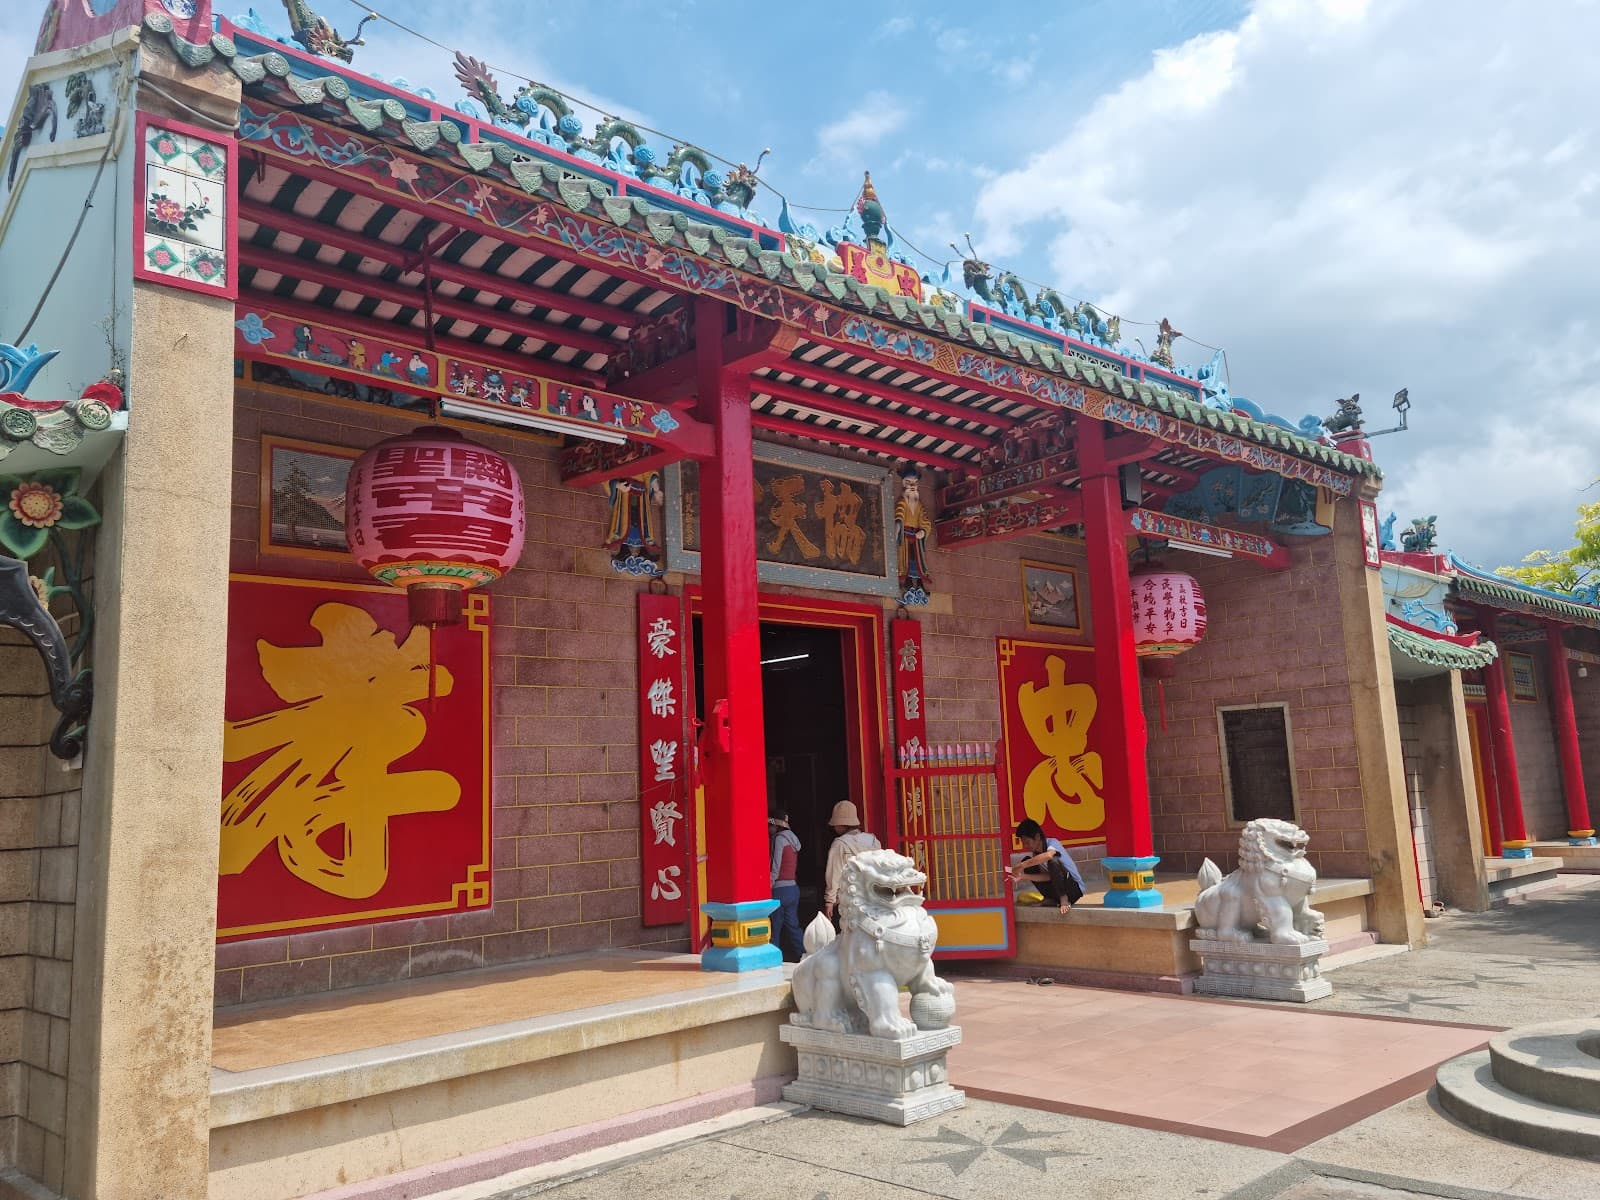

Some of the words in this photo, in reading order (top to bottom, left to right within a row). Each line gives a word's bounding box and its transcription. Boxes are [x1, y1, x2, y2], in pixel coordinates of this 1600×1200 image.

[647, 616, 683, 902] 豪傑聖賢心
[1017, 654, 1106, 832] 忠
